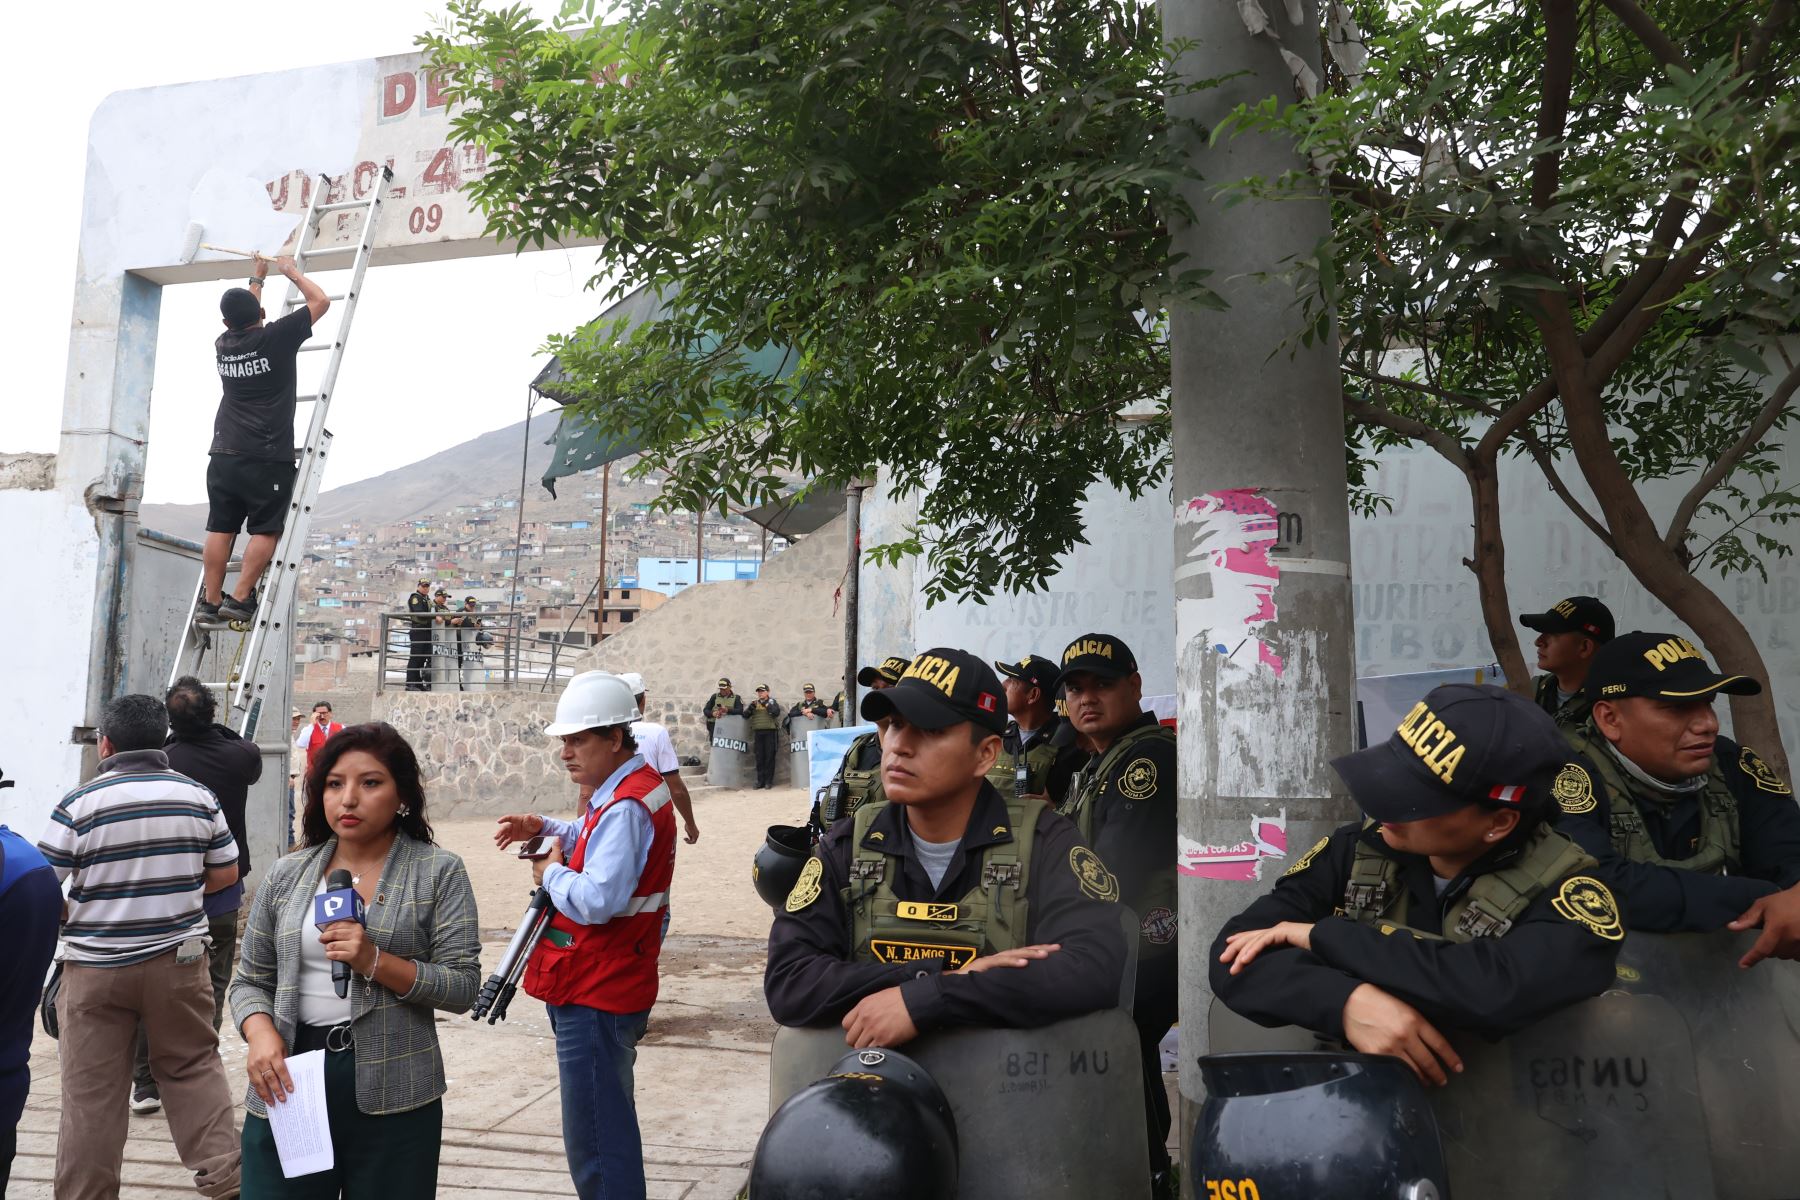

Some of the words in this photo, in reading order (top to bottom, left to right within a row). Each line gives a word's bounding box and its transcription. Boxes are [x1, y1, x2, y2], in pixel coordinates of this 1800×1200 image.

[409, 203, 443, 235] 09
[217, 357, 272, 378] MANAGER
[1064, 640, 1112, 665] POLICIA
[712, 737, 747, 753] POLICIA
[886, 945, 898, 960] N.
[949, 950, 962, 965] L.
